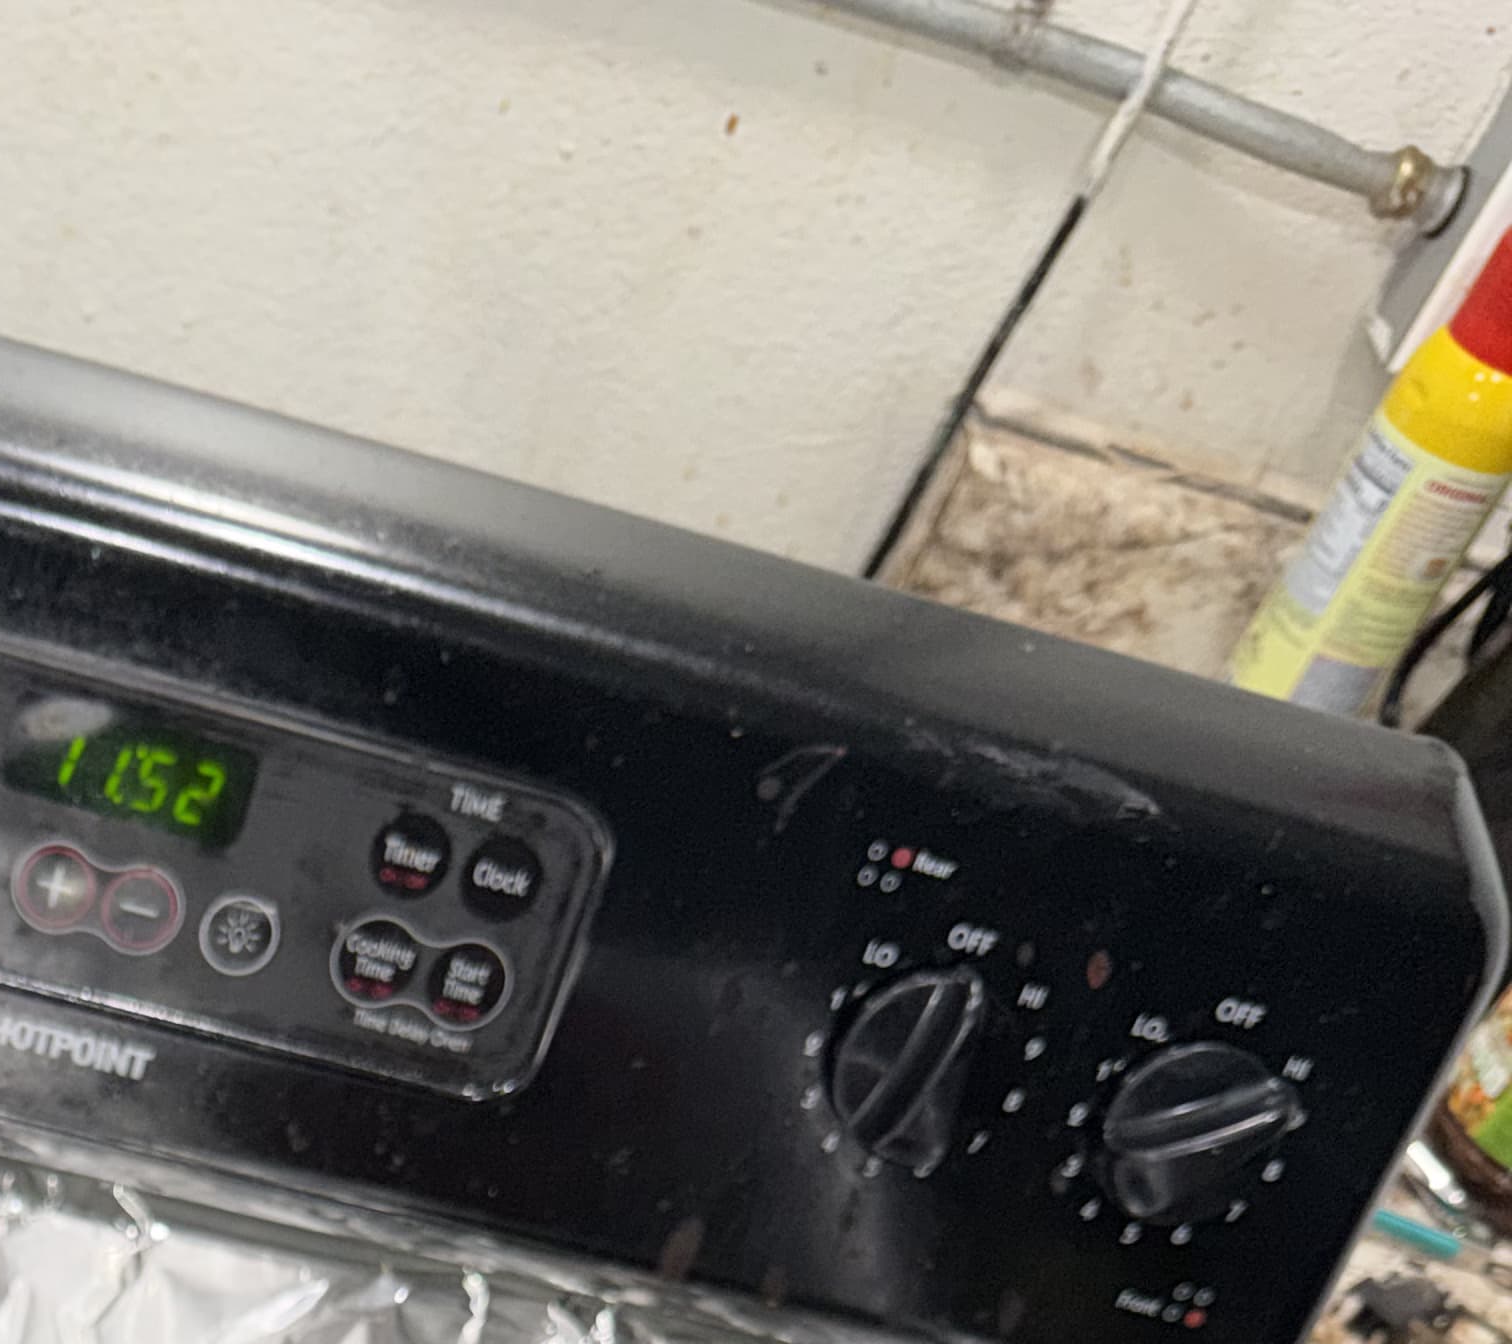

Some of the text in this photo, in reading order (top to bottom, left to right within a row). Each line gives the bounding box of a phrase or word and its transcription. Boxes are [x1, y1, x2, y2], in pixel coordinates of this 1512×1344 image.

[56, 735, 226, 827] 11:52
[450, 782, 506, 823] TIME
[383, 832, 442, 873] Timer
[472, 857, 531, 898] Clock
[862, 936, 899, 969] LO
[946, 921, 999, 957] OFF
[1130, 1013, 1170, 1042] LO
[1214, 998, 1267, 1029] OFF
